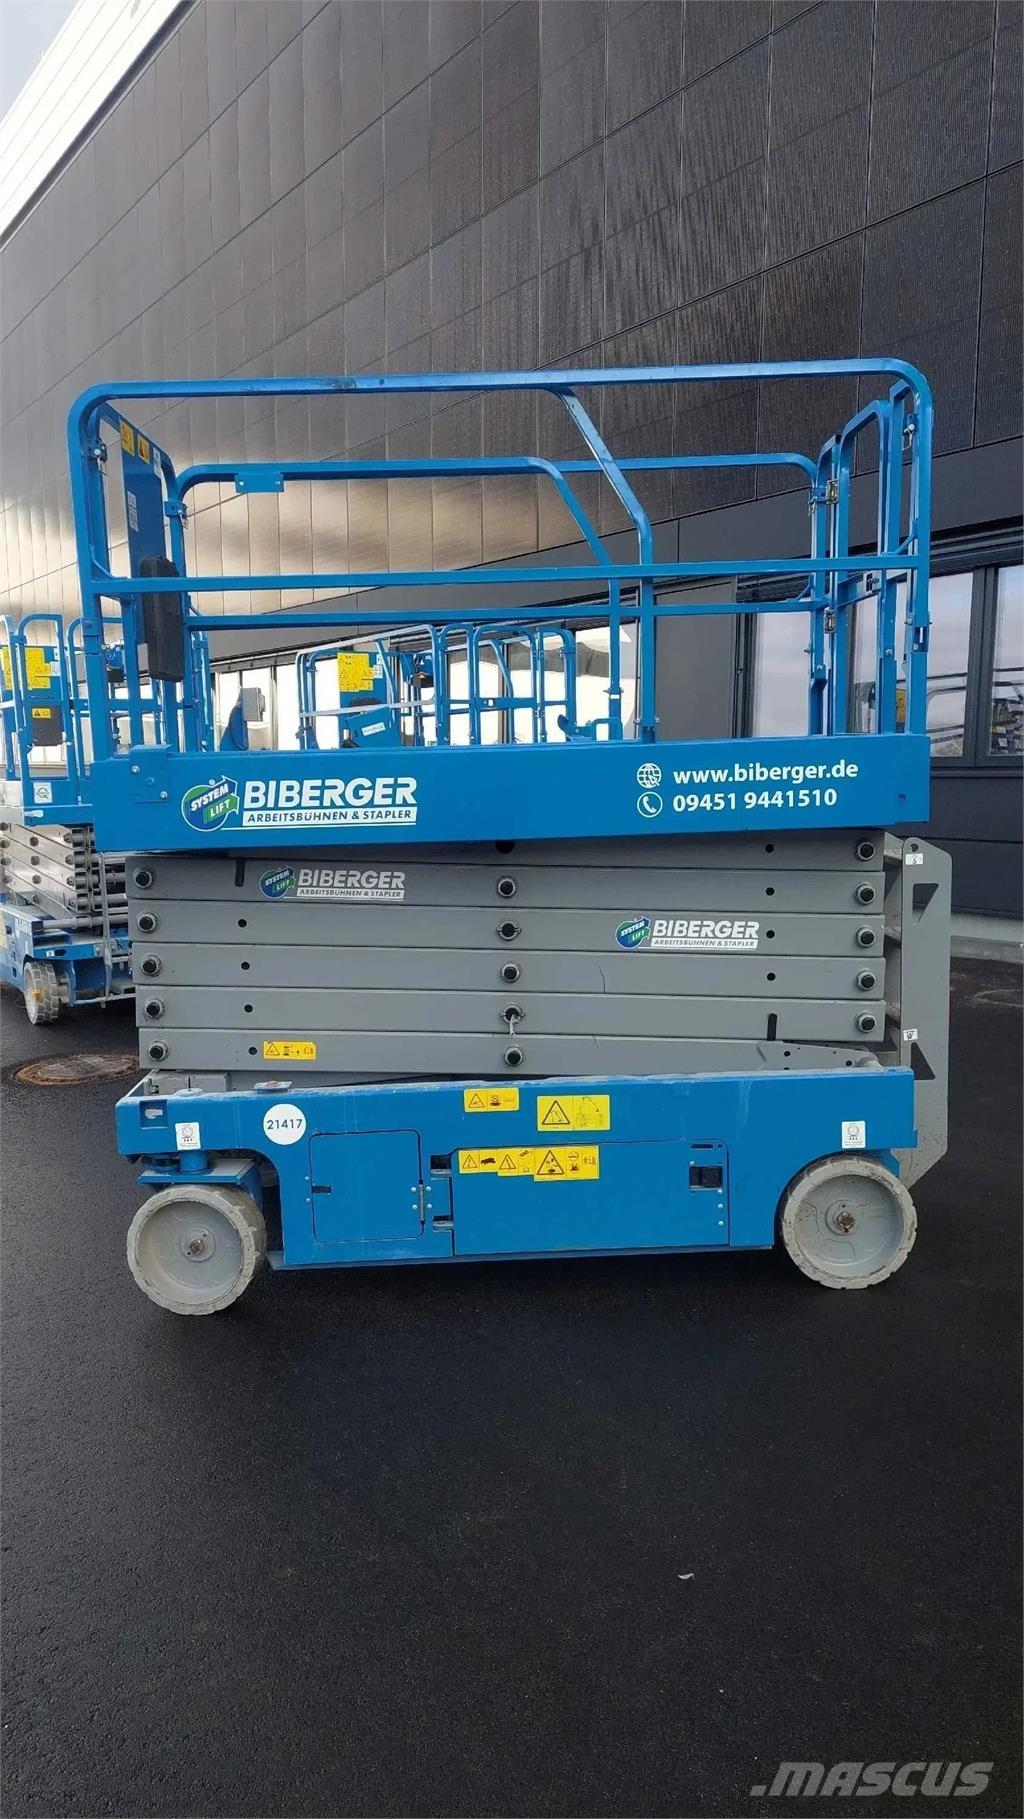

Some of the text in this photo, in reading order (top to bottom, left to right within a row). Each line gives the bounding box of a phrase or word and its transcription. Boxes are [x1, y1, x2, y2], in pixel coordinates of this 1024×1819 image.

[673, 759, 859, 785] www.biberger.de
[190, 783, 229, 812] SYSTEM
[243, 776, 418, 809] BIBERGER
[672, 788, 838, 813] 09451 9441510
[209, 798, 231, 818] LIFT
[247, 808, 412, 824] ARBEITSBÜHNEN & STAPLER
[264, 869, 290, 886] SYSTEM
[276, 879, 290, 891] LIFT
[297, 869, 406, 889] BIBERGER
[370, 889, 401, 898] STAPLER
[620, 920, 645, 937] SYSTEM
[652, 919, 760, 939] BIBERGER
[723, 939, 755, 947] STAPLER
[266, 1118, 303, 1130] 21417
